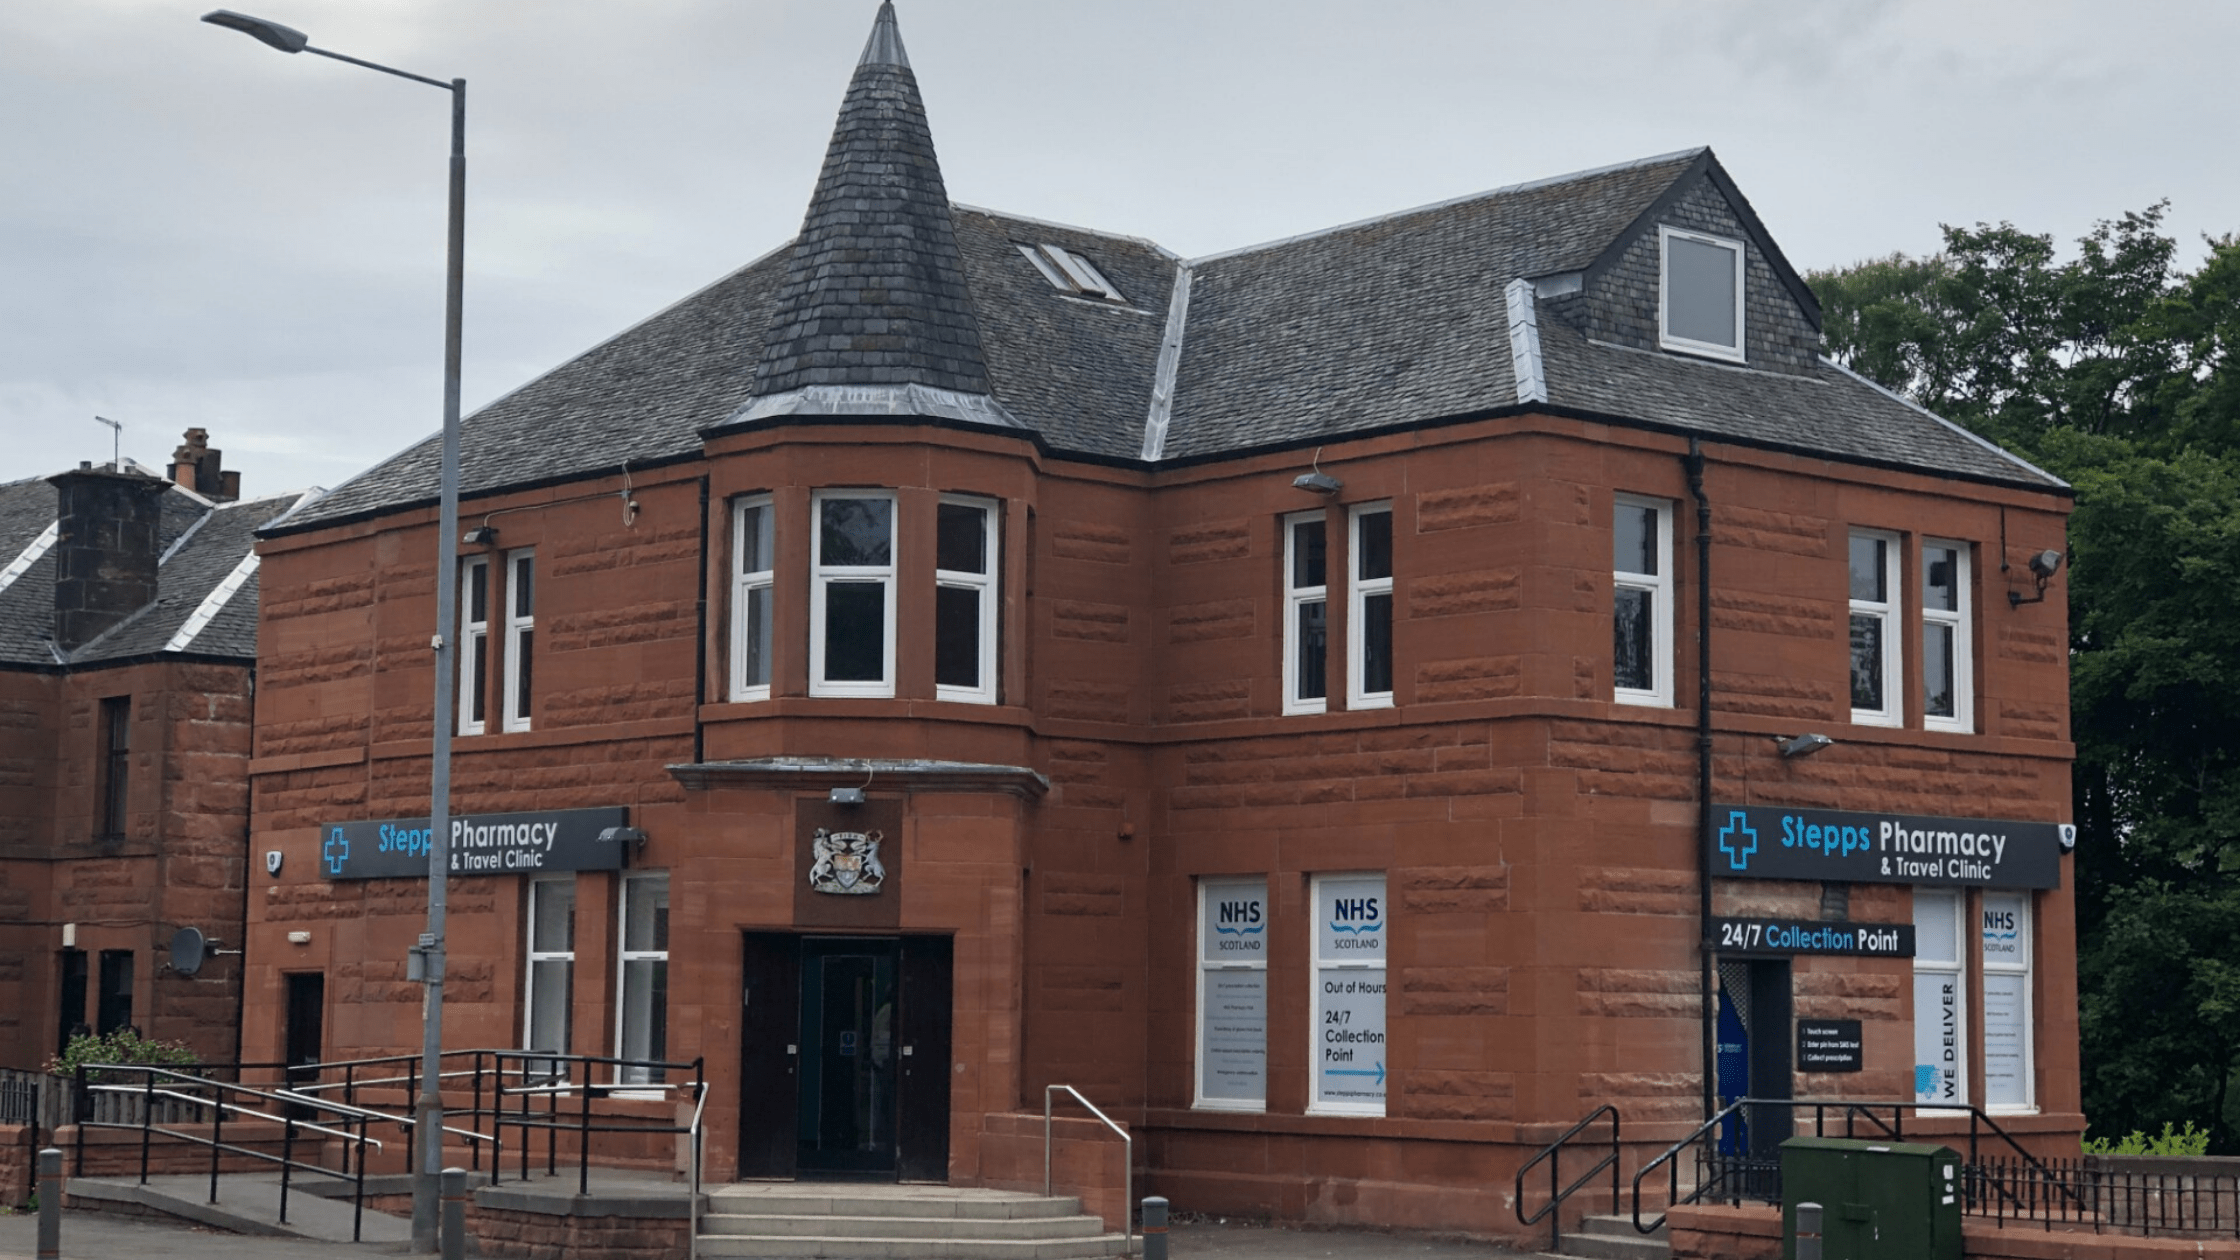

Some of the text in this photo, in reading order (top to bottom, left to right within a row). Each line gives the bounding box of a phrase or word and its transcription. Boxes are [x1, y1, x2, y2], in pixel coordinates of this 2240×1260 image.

[379, 820, 557, 857] Stepp Pharmacy
[1781, 815, 2006, 864] Stepps Pharmacy
[451, 849, 543, 870] & Travel Clinic
[1881, 857, 1991, 879] & Travel Clinic
[1220, 901, 1261, 923] NHS
[1335, 898, 1378, 921] NHS
[1984, 911, 2014, 930] NHS
[1219, 940, 1261, 950] SCOTLAND
[1334, 939, 1379, 949] SCOTLAND
[1722, 923, 1898, 950] 24/7 Collection Point
[1325, 981, 1386, 994] Out of Hours
[1326, 1010, 1351, 1025] 24/7
[1325, 1029, 1385, 1043] Collection
[1943, 984, 1955, 1098] WE DELIVER
[1325, 1048, 1353, 1061] Point
